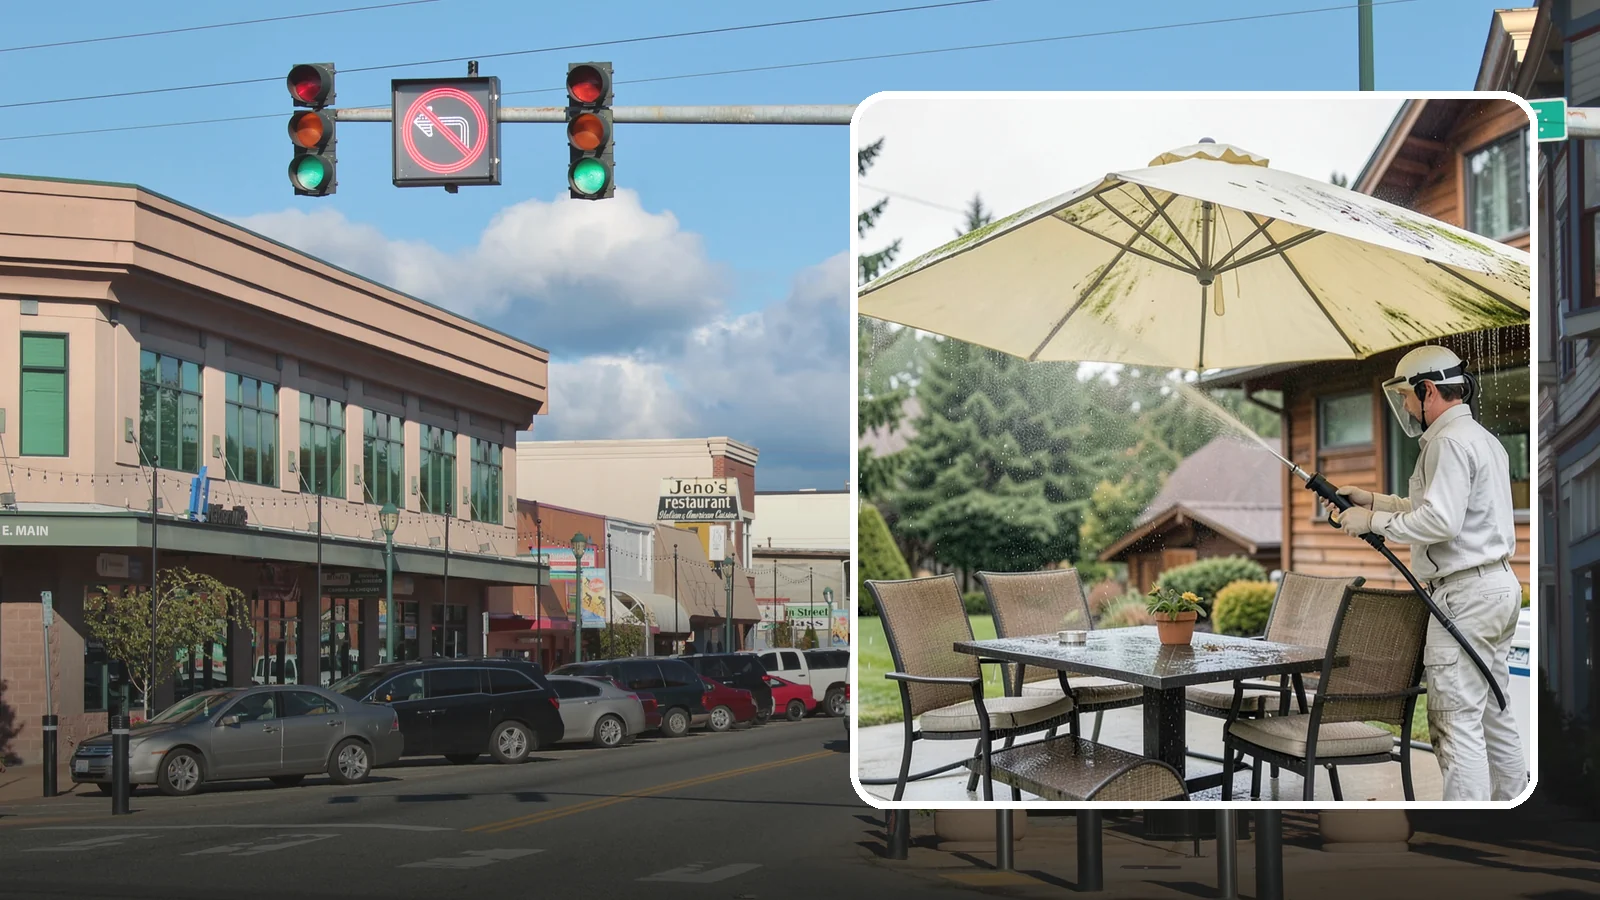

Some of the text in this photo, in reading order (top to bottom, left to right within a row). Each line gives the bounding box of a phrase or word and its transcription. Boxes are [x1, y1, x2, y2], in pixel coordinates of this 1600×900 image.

[670, 480, 727, 495] Jeno's
[665, 496, 731, 509] restaurant
[658, 510, 681, 519] Italian
[686, 509, 714, 519] American
[715, 509, 737, 519] Cuisine
[2, 525, 49, 536] E. MAIN
[797, 607, 828, 617] Street
